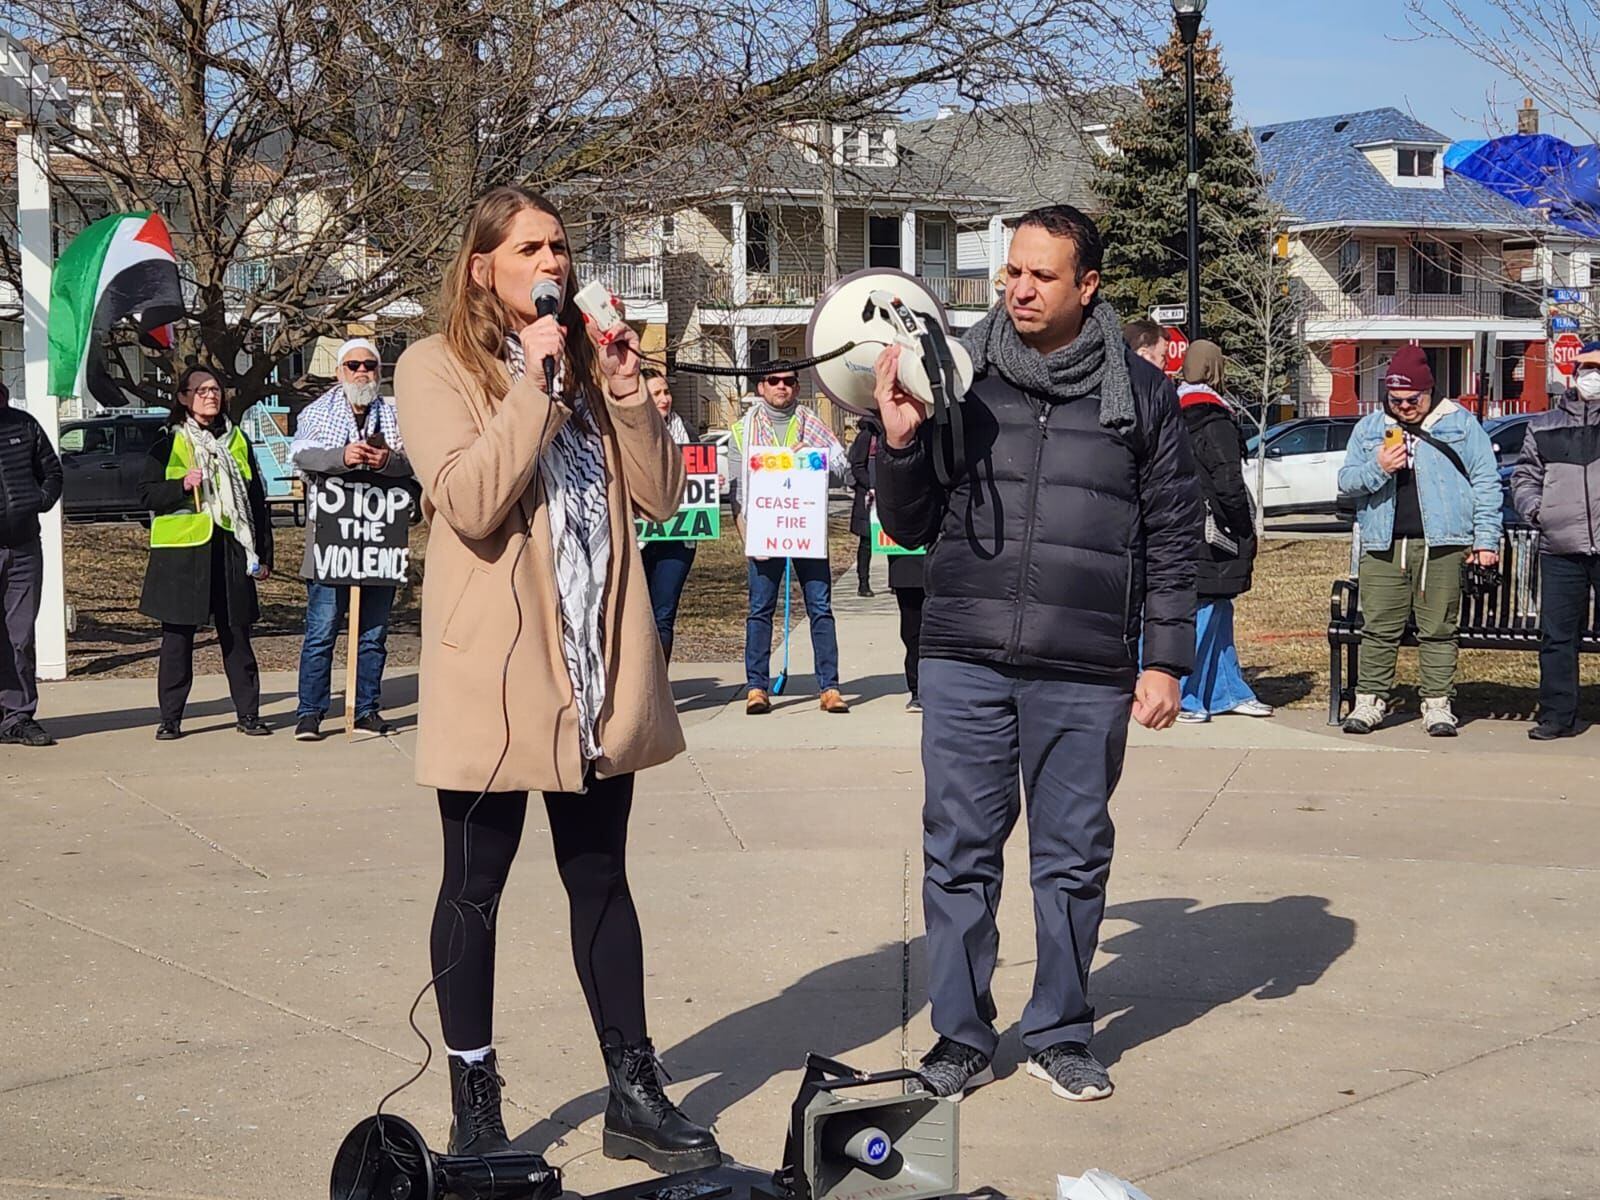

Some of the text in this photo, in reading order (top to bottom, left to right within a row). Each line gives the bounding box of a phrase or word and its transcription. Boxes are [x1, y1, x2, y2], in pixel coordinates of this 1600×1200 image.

[1171, 310, 1182, 318] WAY
[1168, 341, 1186, 358] OP
[682, 445, 716, 473] ELI
[682, 479, 716, 504] DE
[783, 477, 791, 490] 4
[317, 476, 410, 524] STOP
[337, 518, 386, 542] THE
[776, 516, 807, 528] FIRE
[766, 537, 811, 550] NOW
[313, 543, 409, 582] VIOLENCE
